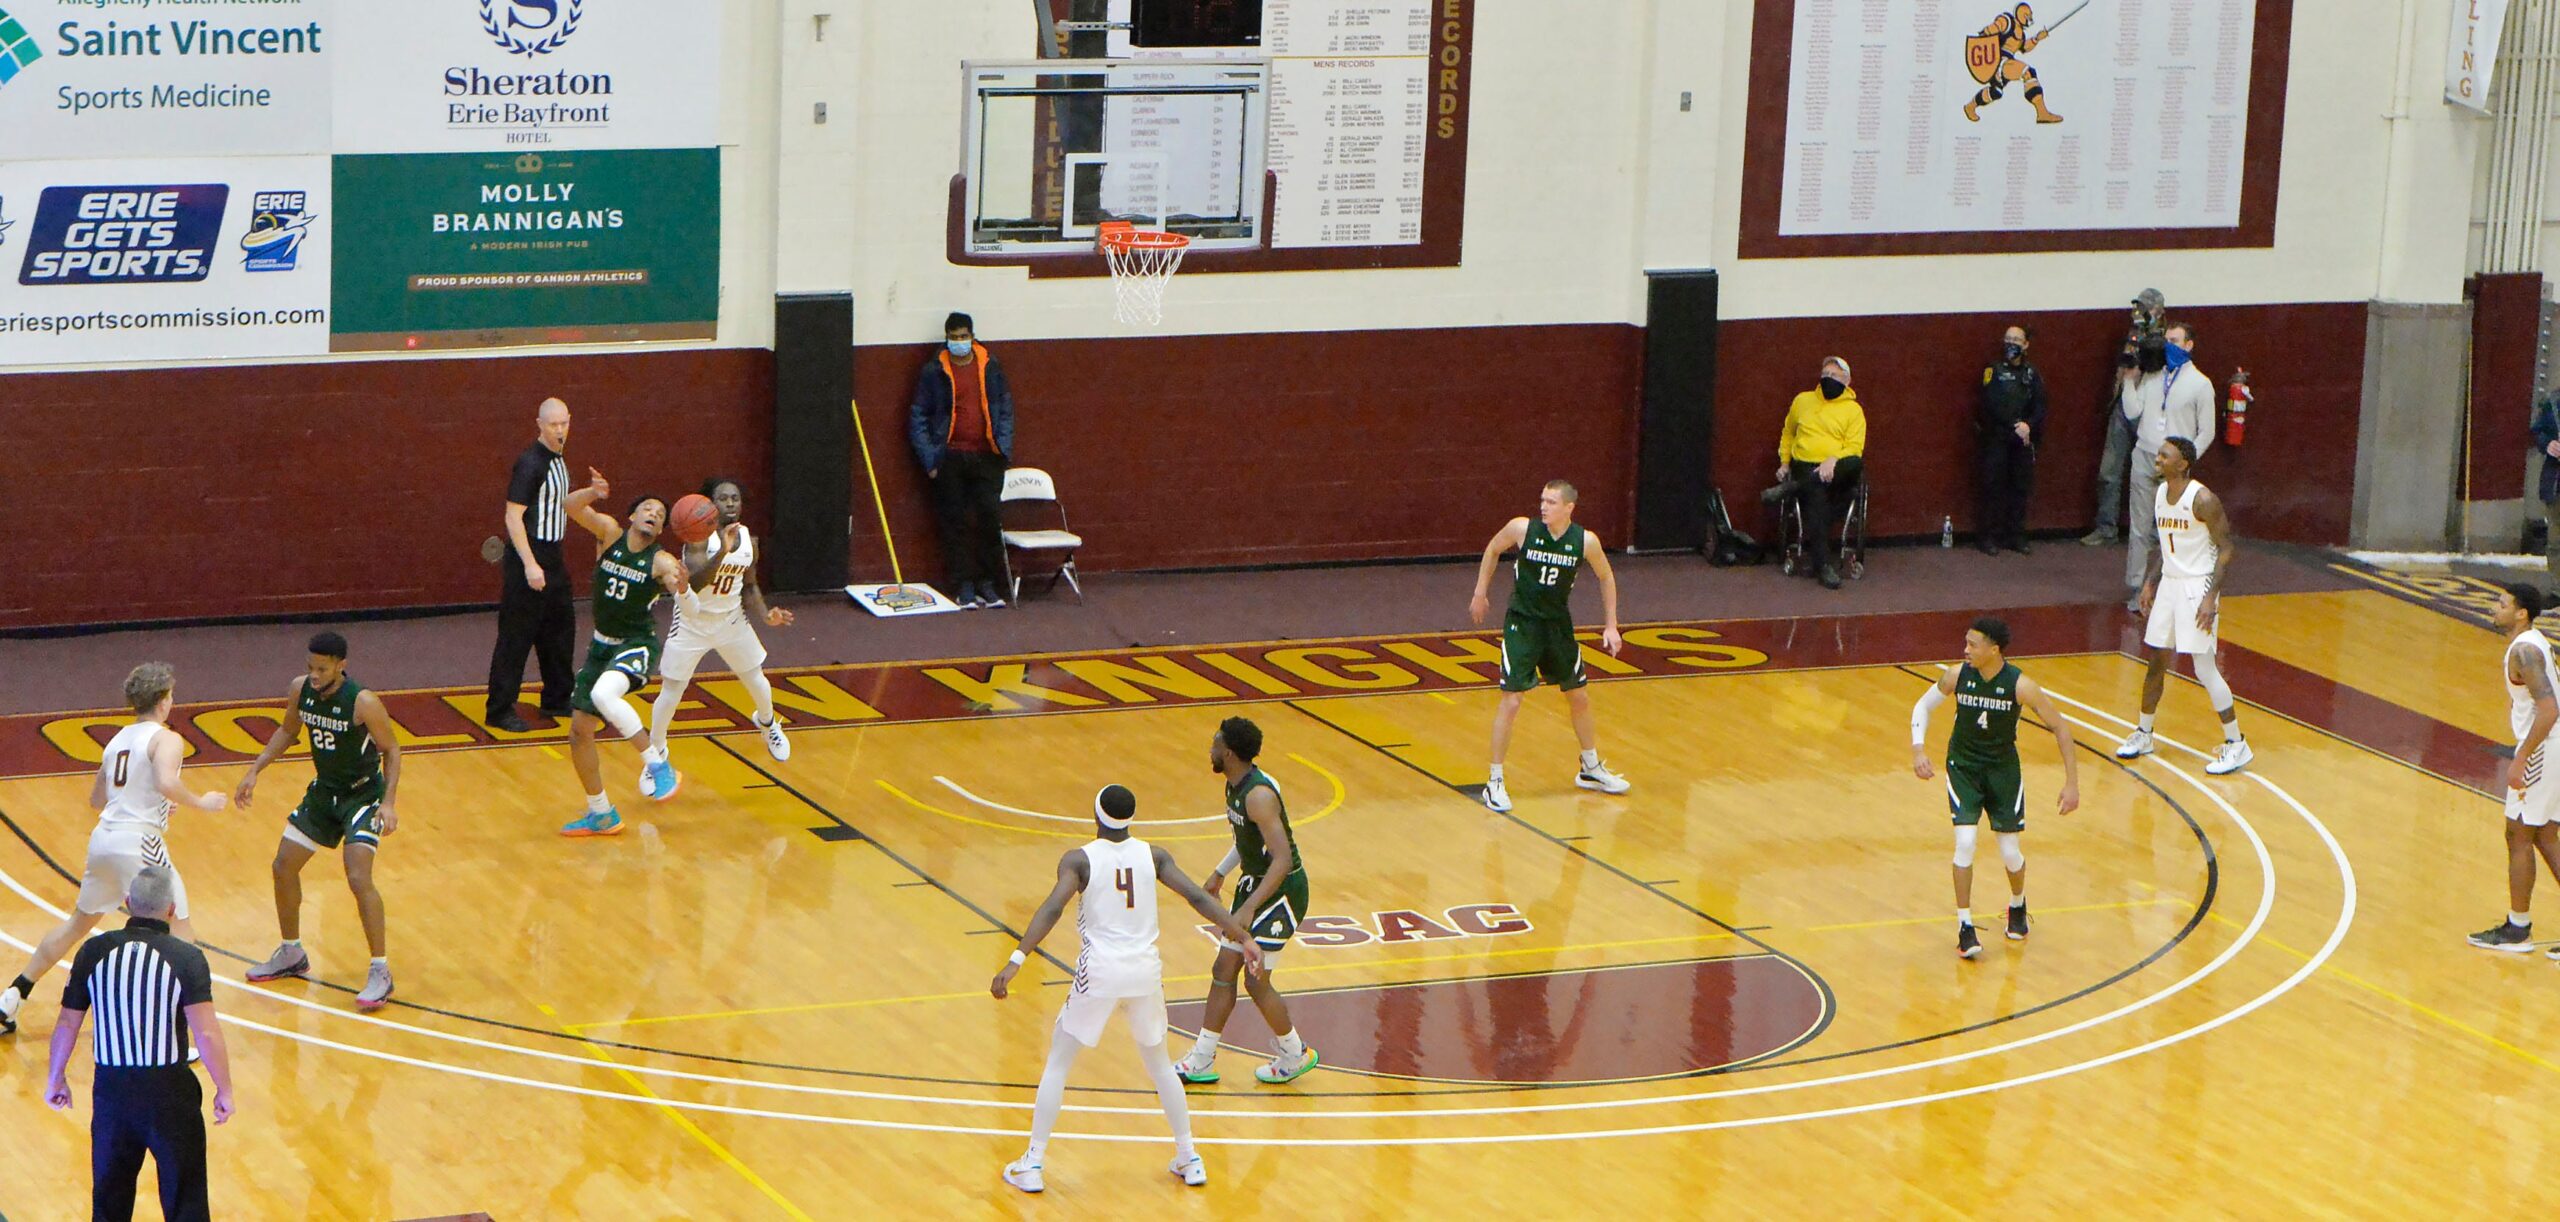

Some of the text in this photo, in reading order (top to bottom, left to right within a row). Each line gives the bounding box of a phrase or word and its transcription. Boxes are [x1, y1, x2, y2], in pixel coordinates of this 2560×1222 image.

[57, 20, 322, 56] Saint Vincent
[2459, 0, 2480, 98] LING
[1313, 60, 1375, 68] MENS RECORDS
[1971, 43, 1996, 67] GU
[1437, 0, 1461, 139] ECORDS
[444, 66, 614, 97] Sheraton
[57, 83, 271, 115] Sports Medicine
[447, 102, 610, 128] Erie Bayfront
[505, 132, 552, 144] HOTEL
[255, 193, 304, 210] ERIE
[481, 183, 575, 204] MOLLY
[78, 192, 179, 219] ERIE
[433, 207, 624, 233] BRANNIGAN'S
[64, 221, 177, 249] GETS
[481, 242, 529, 250] MODERN
[532, 241, 563, 249] IRISH
[566, 240, 589, 248] PUB
[417, 271, 644, 287] PROUD SPONSOR OF GANNON ATHLETICS
[0, 306, 325, 336] eriesportscommission.com
[1008, 477, 1043, 489] GANNON
[2158, 516, 2189, 530] KNIGHTS
[2168, 532, 2176, 554] 1
[1526, 549, 1578, 567] MERCYHURST
[601, 558, 648, 584] MERCYHURST
[1538, 565, 1559, 586] 12
[604, 576, 629, 601] 33
[712, 575, 735, 595] 40
[1957, 693, 2013, 712] MERCYHURST
[299, 710, 349, 732] MERCYHURST
[1977, 710, 1989, 729] 4
[312, 728, 336, 751] 22
[113, 749, 131, 788] 0
[1115, 867, 1135, 909] 4
